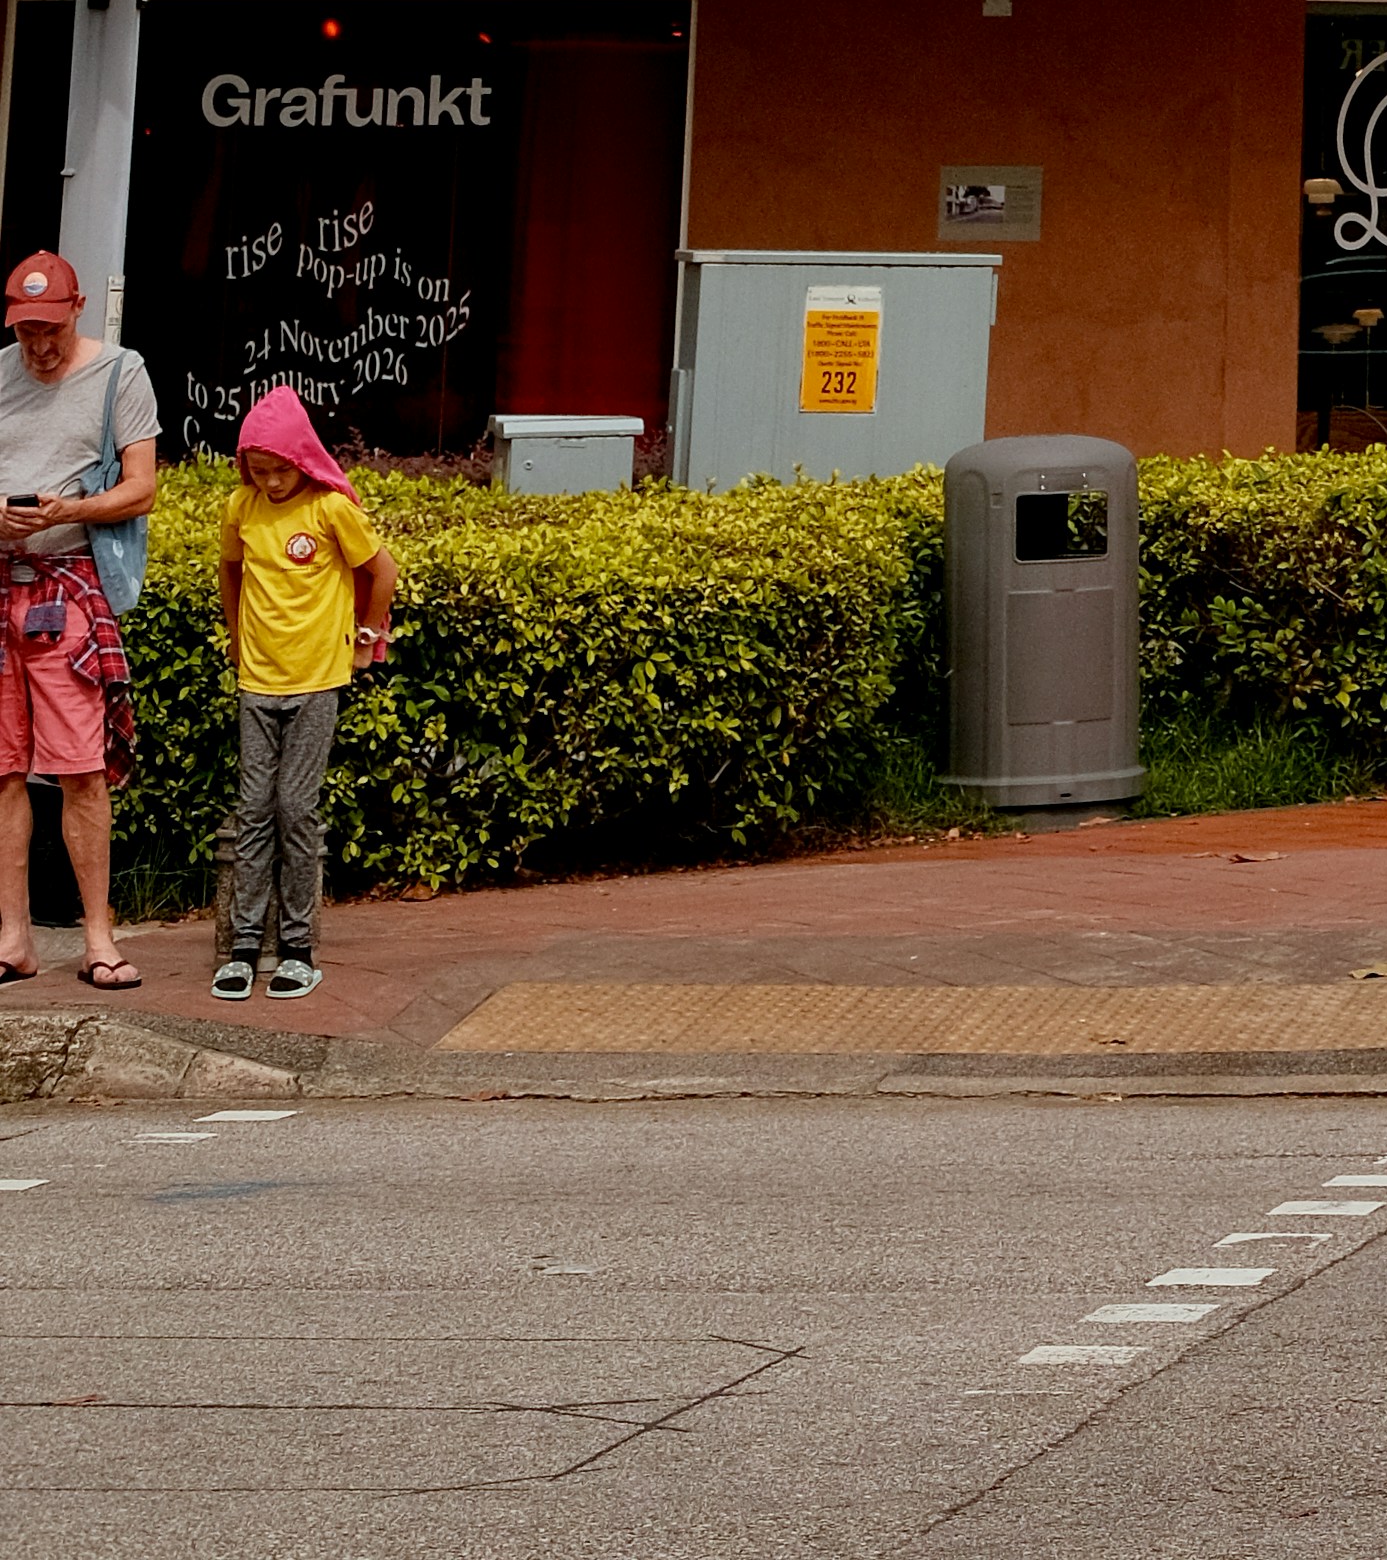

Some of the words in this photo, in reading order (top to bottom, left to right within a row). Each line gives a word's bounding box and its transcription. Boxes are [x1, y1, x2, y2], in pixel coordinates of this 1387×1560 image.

[201, 73, 493, 128] Grafunkt
[225, 222, 283, 280] rise
[318, 201, 374, 252] rise
[297, 243, 386, 299] pop-up
[394, 248, 412, 287] is
[418, 276, 450, 303] on
[243, 328, 271, 375] 24
[280, 307, 410, 363] November
[415, 289, 472, 348] 2025
[187, 371, 208, 410] to
[214, 386, 242, 421] 25
[352, 347, 408, 396] 2026
[821, 370, 857, 394] 232
